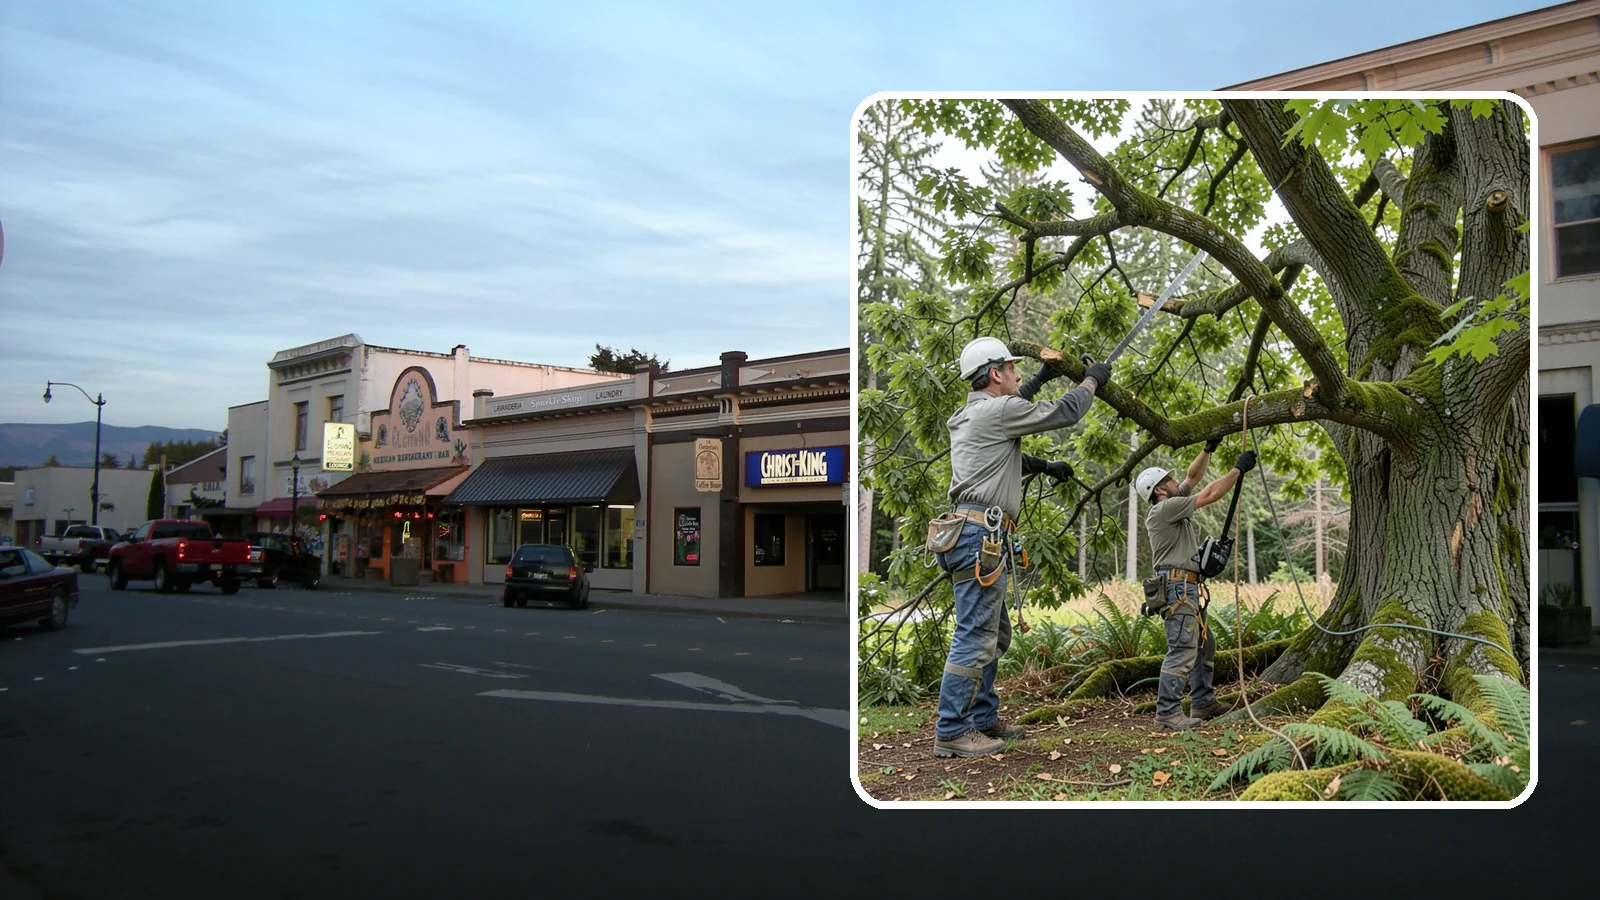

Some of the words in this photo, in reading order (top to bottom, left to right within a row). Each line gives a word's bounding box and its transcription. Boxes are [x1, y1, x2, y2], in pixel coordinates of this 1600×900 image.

[562, 394, 582, 405] Shop
[595, 389, 624, 400] LAUNDRY
[494, 401, 522, 412] LAVANDERIA
[373, 455, 396, 464] MEXICAN
[397, 451, 433, 463] RESTAURANT
[437, 450, 450, 459] BAR
[761, 452, 797, 477] CHRIST
[799, 450, 827, 476] KING
